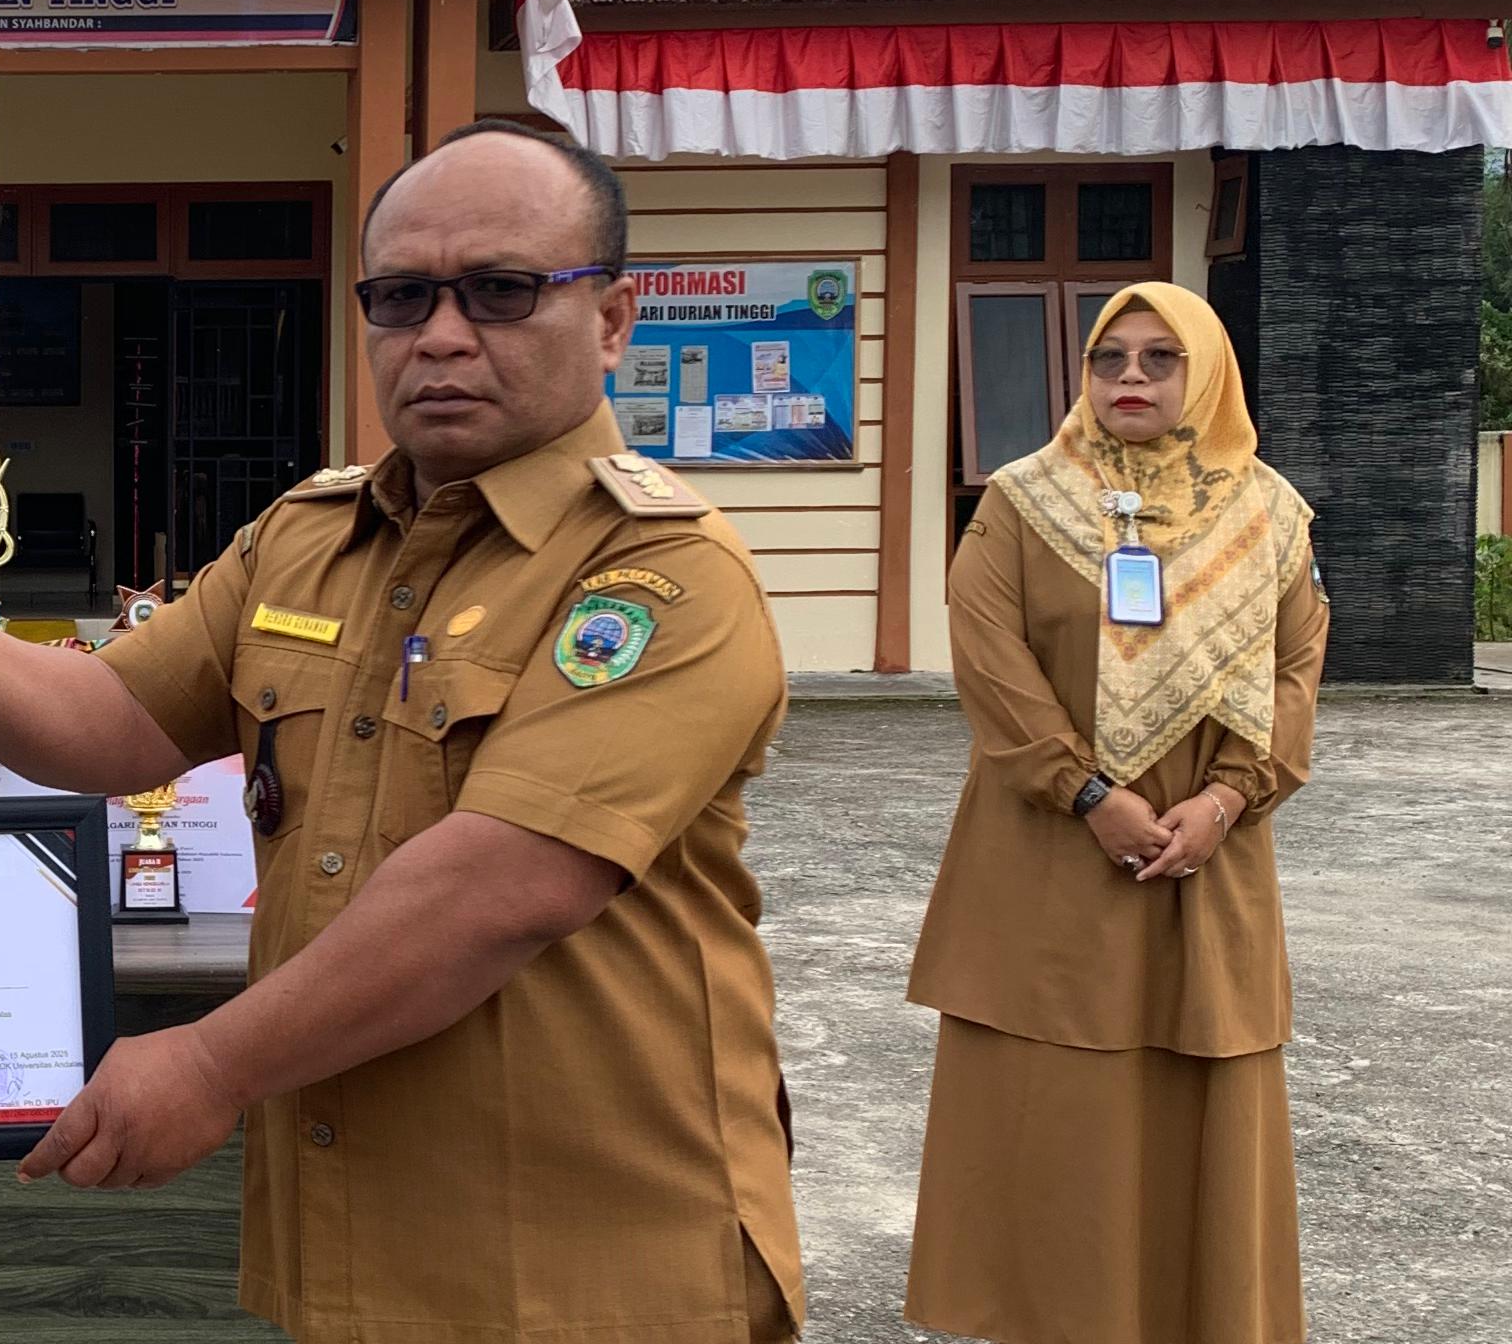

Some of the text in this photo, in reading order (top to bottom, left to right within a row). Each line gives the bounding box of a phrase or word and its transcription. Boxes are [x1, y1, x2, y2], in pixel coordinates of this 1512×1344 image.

[12, 18, 94, 29] SYAHBANDAR
[623, 270, 746, 296] NFORMASI
[667, 305, 723, 321] DURIAN
[725, 304, 775, 320] TINGGI
[182, 821, 218, 829] TINGGI
